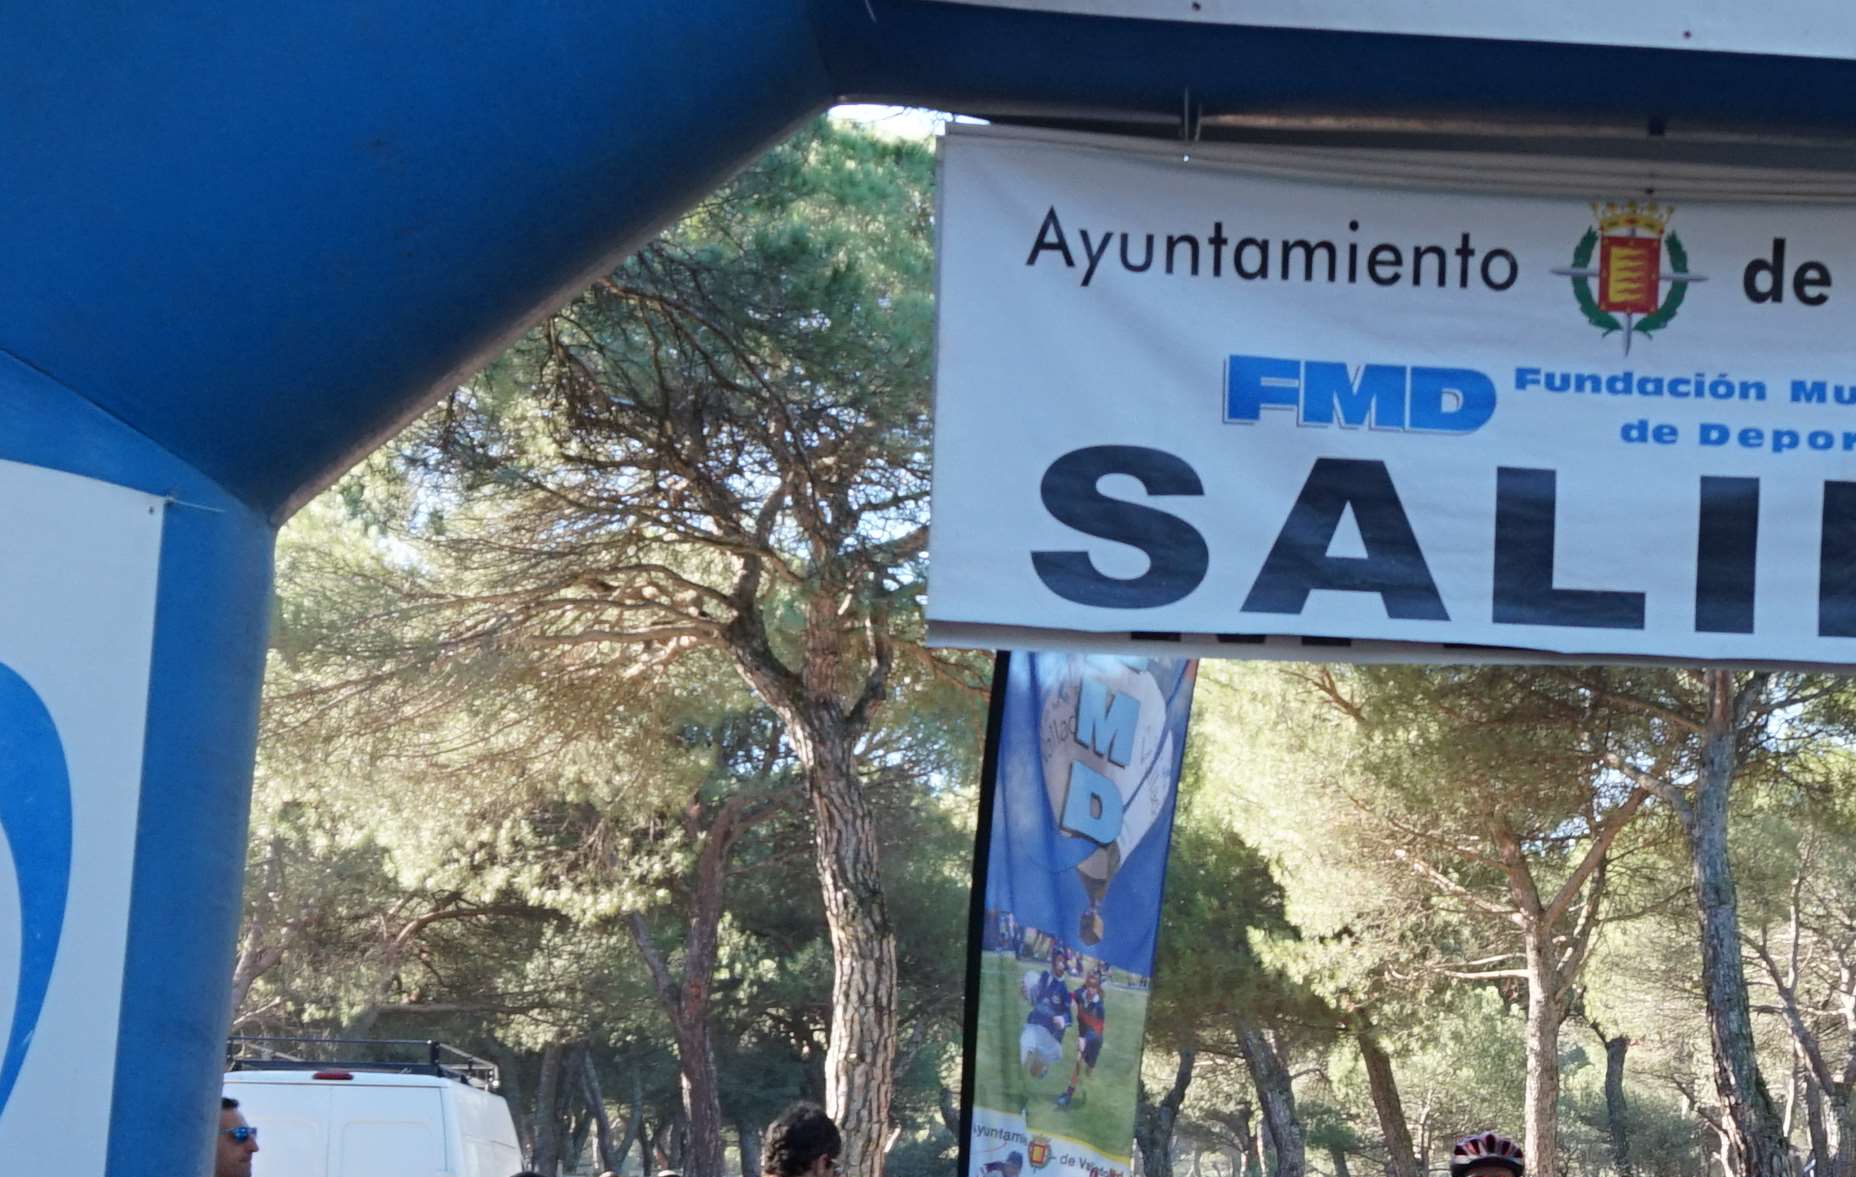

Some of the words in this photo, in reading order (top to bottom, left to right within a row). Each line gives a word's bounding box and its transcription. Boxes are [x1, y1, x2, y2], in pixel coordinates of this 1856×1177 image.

[1026, 205, 1519, 292] Ayuntamiento
[1742, 237, 1833, 306] de
[1222, 354, 1498, 436] FMD
[1514, 366, 1768, 402] Fundación
[1619, 418, 1680, 445] de
